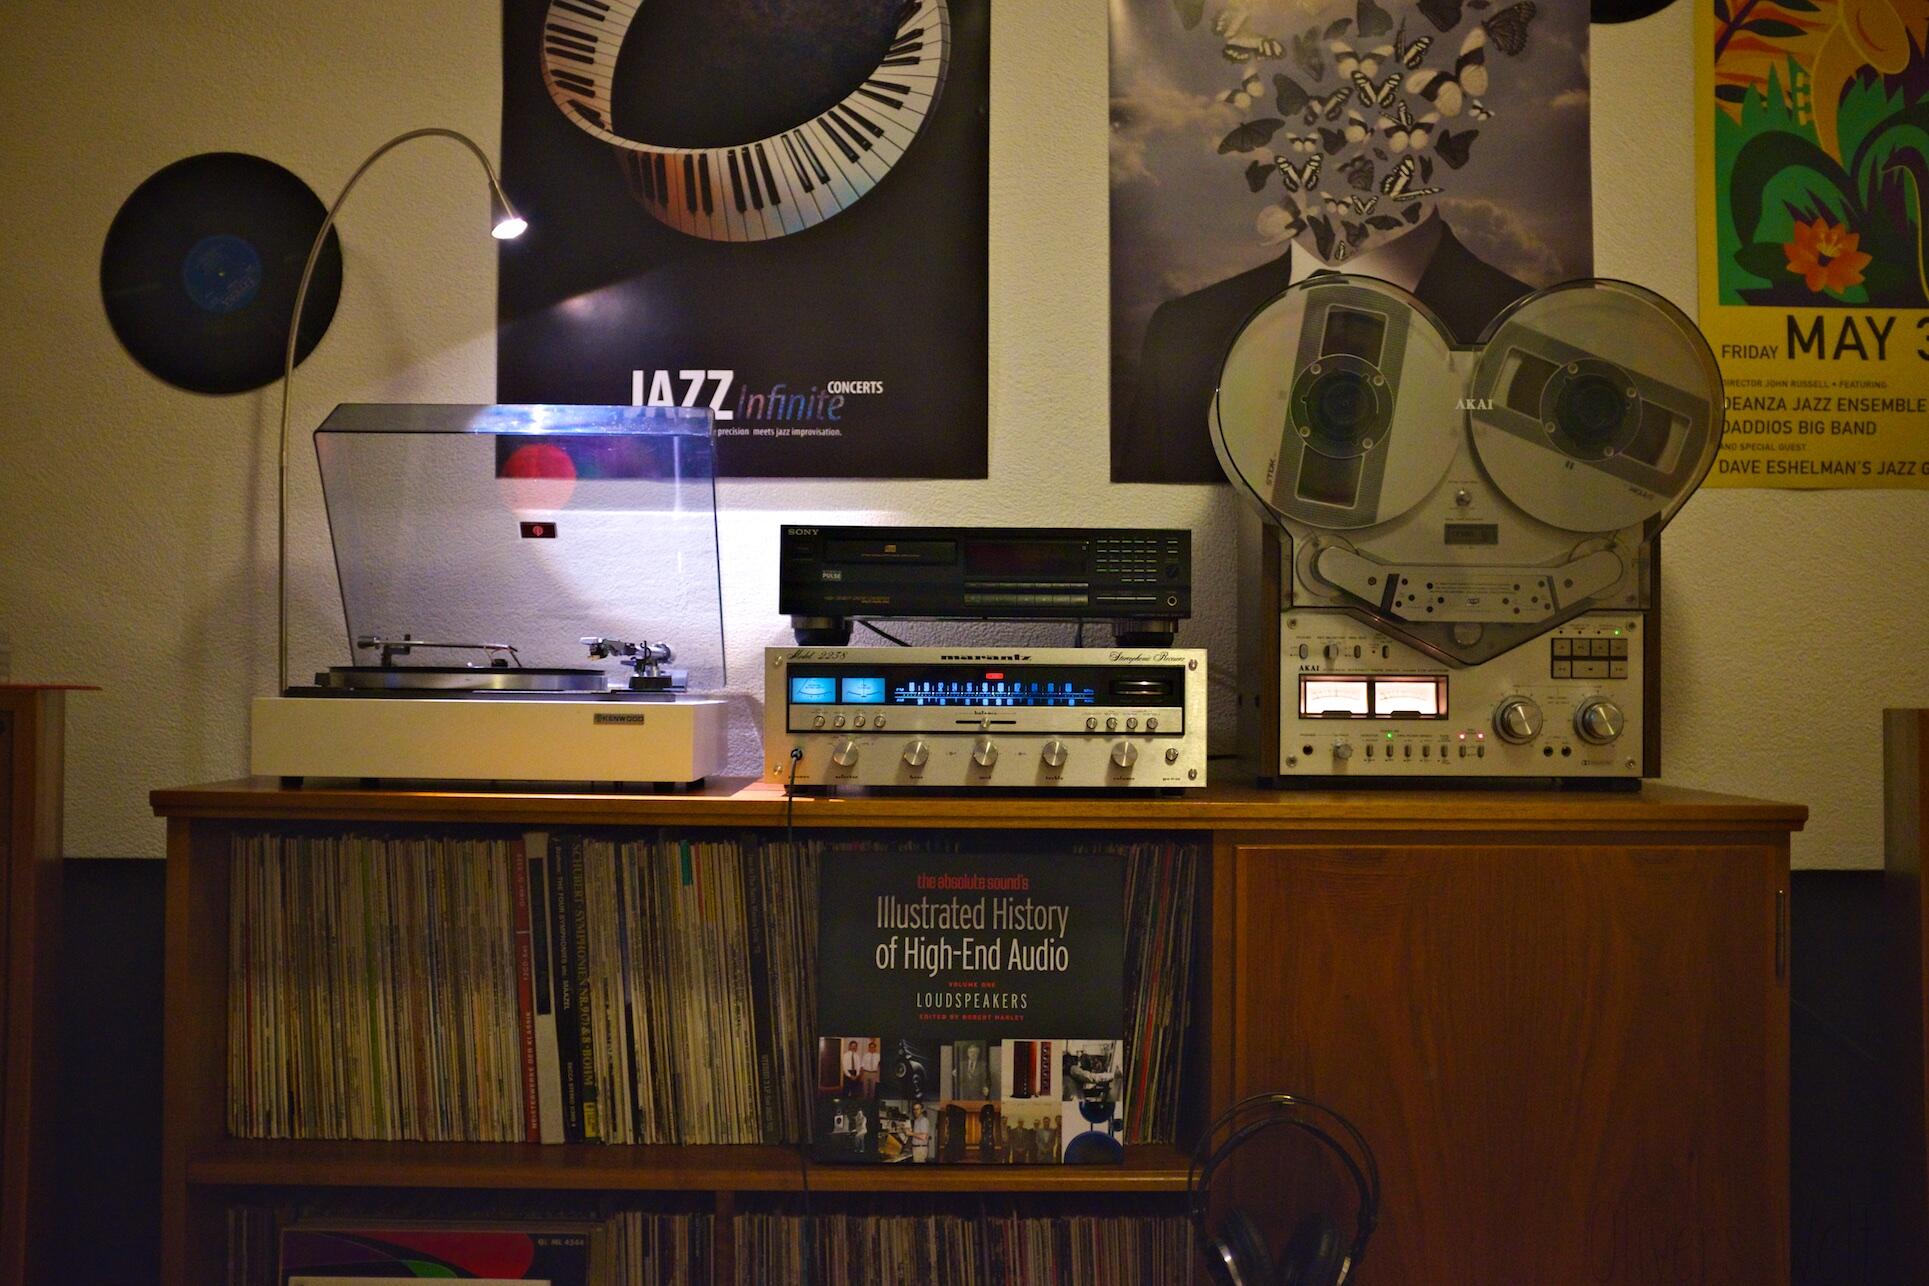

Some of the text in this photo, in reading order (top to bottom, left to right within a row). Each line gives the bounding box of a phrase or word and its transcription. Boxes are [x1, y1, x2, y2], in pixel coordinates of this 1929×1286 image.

[1721, 345, 1778, 359] FRIDAY
[1787, 315, 1896, 361] MAY
[827, 380, 884, 395] CONCERTS
[1765, 380, 1788, 388] JOHN
[1790, 380, 1829, 388] RUSSELL
[1838, 381, 1888, 389] FEATURING
[628, 369, 845, 421] JAZZ Infinite
[1456, 399, 1494, 410] AKAI
[1724, 396, 1927, 413] DEANZA JAZZ ENSEMBLE
[717, 428, 749, 438] precision
[1723, 420, 1877, 436] DADDIOS BIG BAND
[1739, 443, 1776, 452] SPECIAL
[1778, 444, 1807, 452] GUEST
[1719, 459, 1761, 475] DAVE
[1766, 460, 1871, 475] ESHELMAN'S
[1877, 462, 1915, 476] JAZZ
[786, 528, 820, 536] SONY
[941, 653, 1031, 662] marantz
[1299, 664, 1320, 672] AKAI
[602, 715, 644, 723] KENWOOD
[916, 873, 1029, 891] the absolute sound's
[876, 895, 1070, 937] Illustrated History
[875, 937, 1070, 978] of High-End Audio
[916, 992, 1028, 1009] LOUDSPEAKERS
[919, 1013, 947, 1021] EDITED
[950, 1013, 960, 1021] BY
